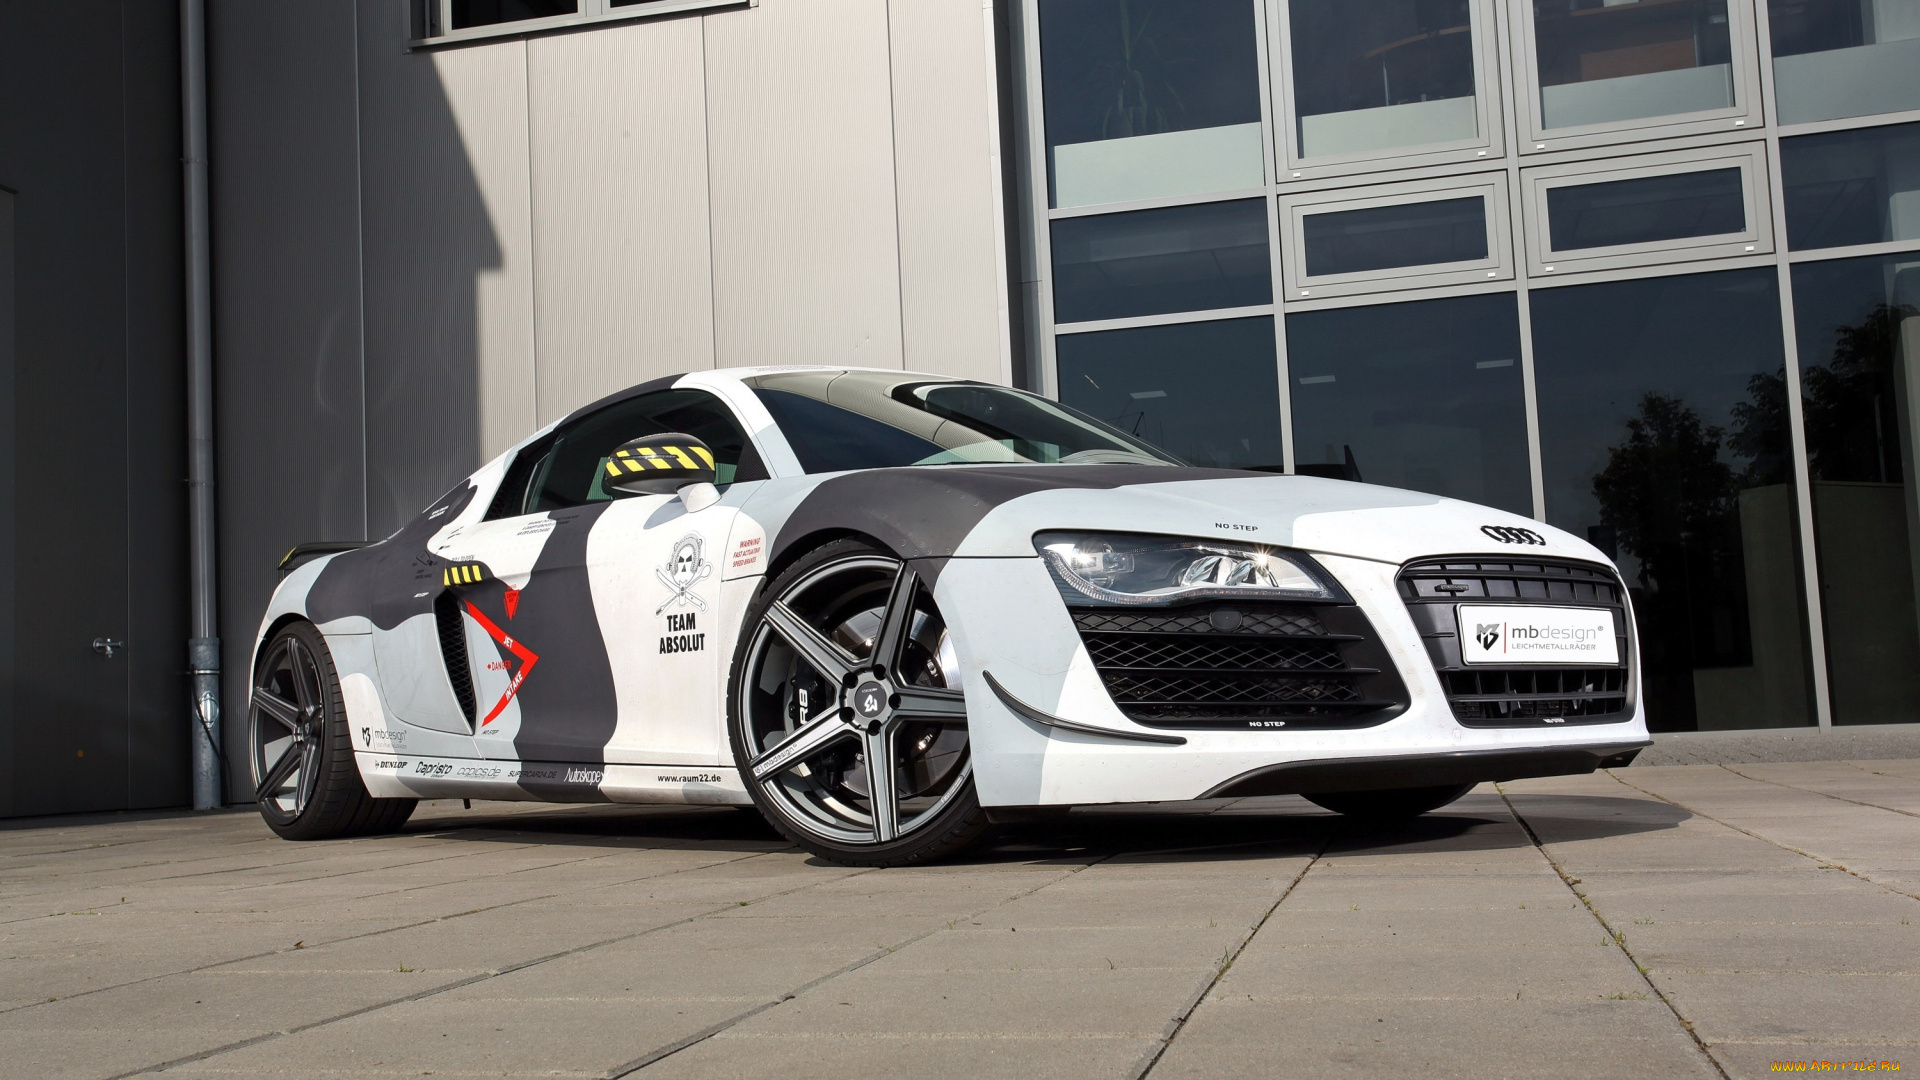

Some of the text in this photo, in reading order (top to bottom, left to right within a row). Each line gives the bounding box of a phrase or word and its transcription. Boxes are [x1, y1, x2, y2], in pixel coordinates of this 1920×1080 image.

[1233, 524, 1259, 532] STEP
[740, 537, 761, 548] WARNING
[667, 612, 696, 632] TEAM
[503, 636, 514, 649] JET
[659, 633, 705, 654] ABSOLUT
[1511, 643, 1597, 651] LEICHTMETALLRÄDER
[491, 660, 512, 671] DANGER
[505, 670, 523, 700] INTAKE
[380, 761, 408, 769] DUNLOP
[415, 761, 453, 776] Capristo
[657, 773, 722, 783] www.raum22.de
